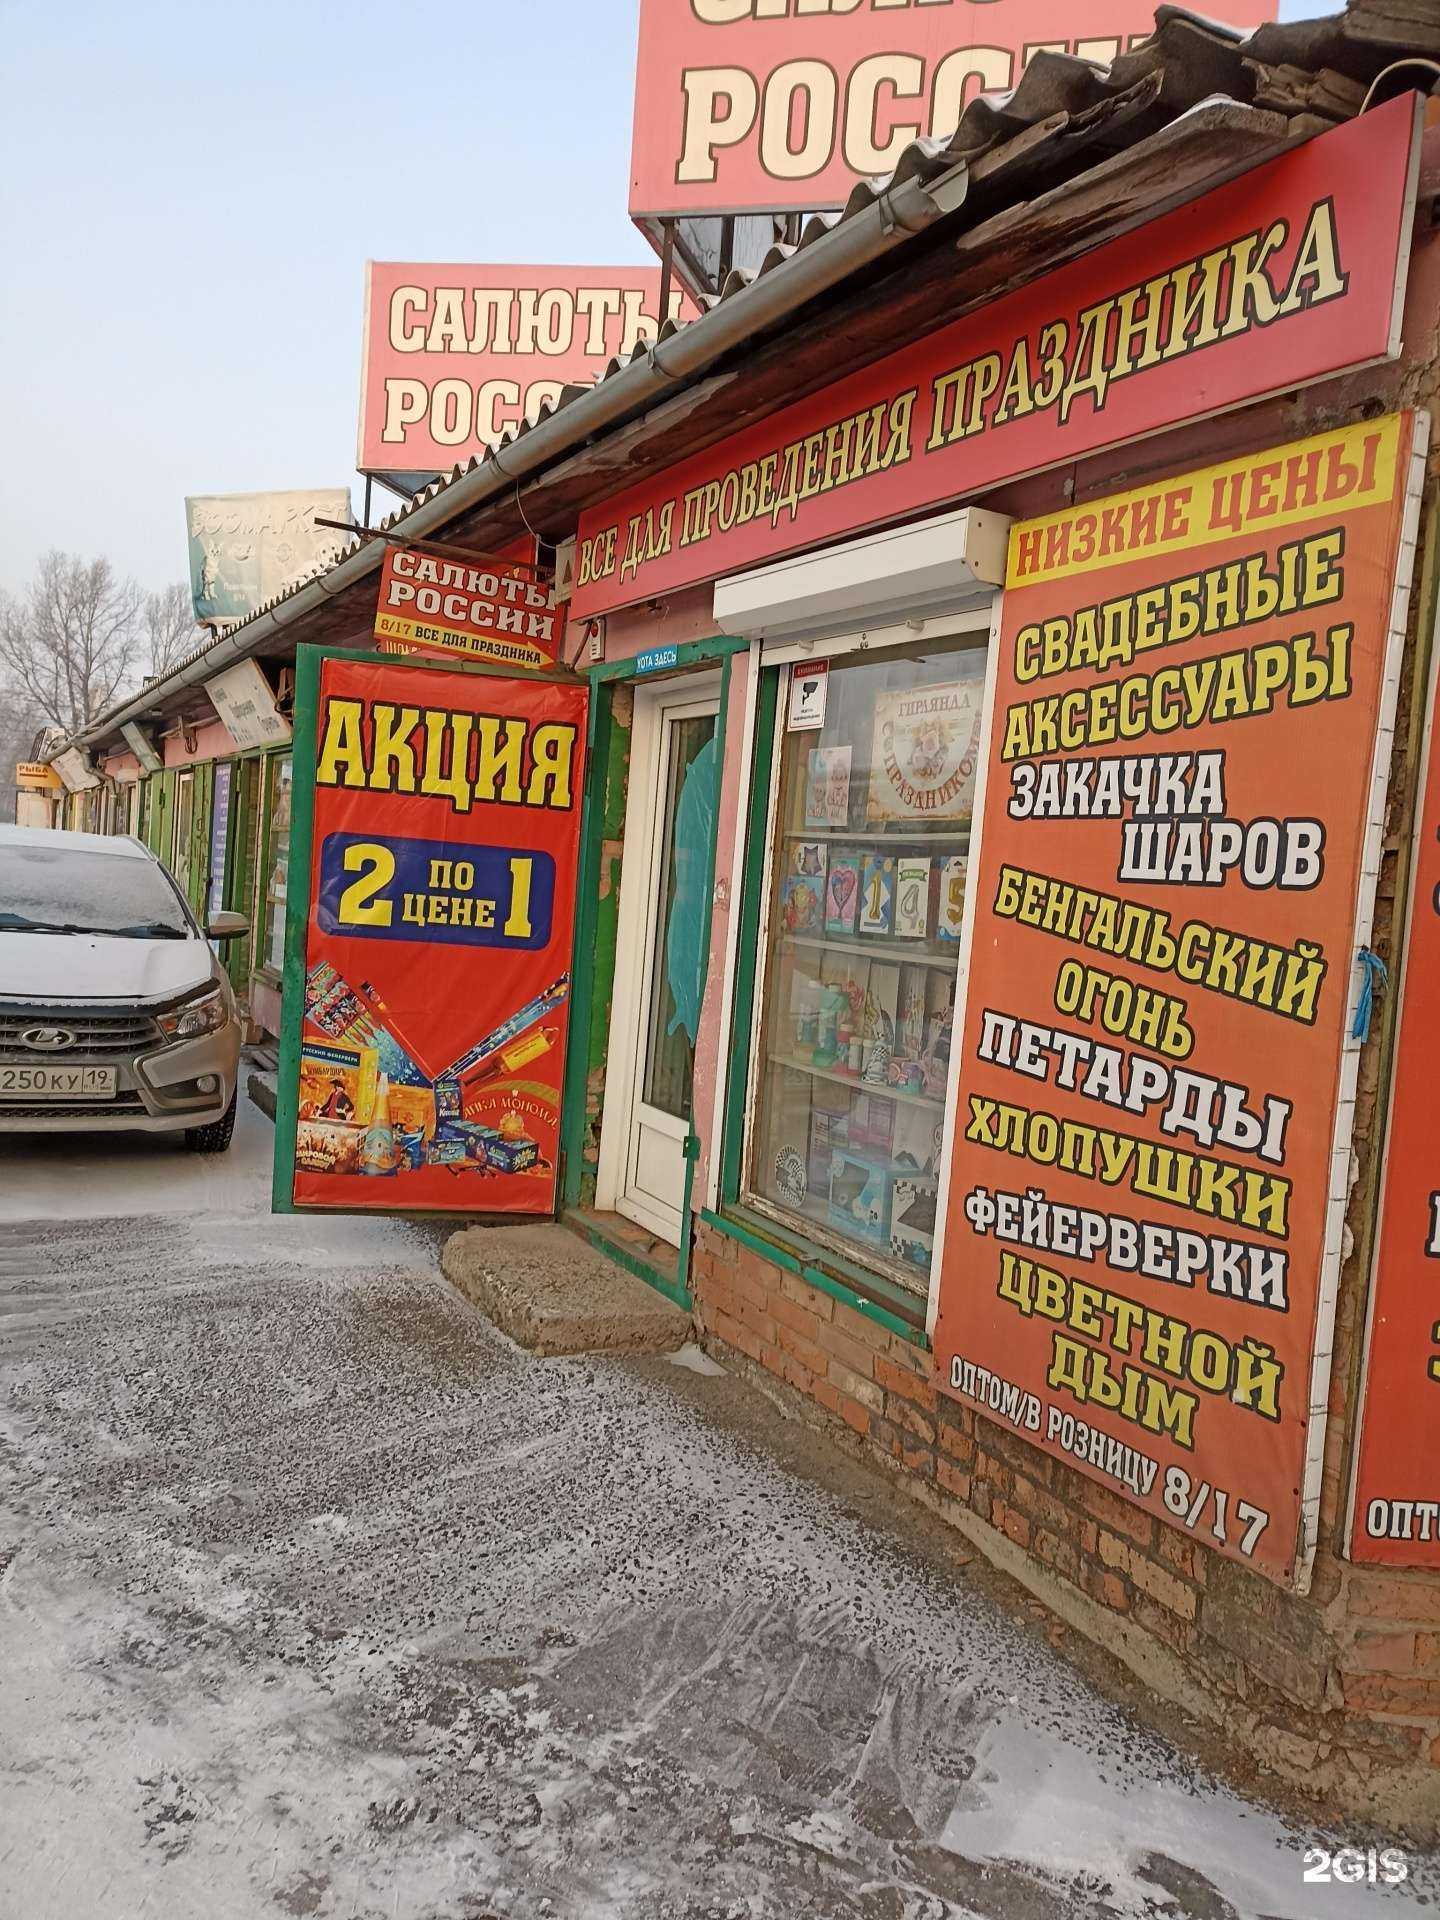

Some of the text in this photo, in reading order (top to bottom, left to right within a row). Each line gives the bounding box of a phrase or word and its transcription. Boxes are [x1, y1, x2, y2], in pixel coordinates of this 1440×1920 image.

[675, 34, 1160, 184] РОСС
[577, 198, 1346, 584] ВСЕ ДЛЯ ПРОВЕДЕНИЯ ПРАЗДНИКА
[1015, 434, 1381, 577] НИЗКИЕ ЦЕНЫ
[387, 580, 555, 640] РОССИИ
[392, 552, 557, 610] САЛЮТЫ
[1013, 526, 1345, 684] СВАДЕБНЫЕ
[380, 619, 541, 664] 8/17 ВСЕ ДЛЯ ПРАЗДНИКА
[655, 650, 677, 665] ЗДЕСЬ
[1001, 623, 1353, 762] АКСЕССУАРЫ
[315, 697, 578, 814] АКЦИЯ
[1007, 749, 1227, 820] ЗАКАЧКА
[338, 842, 396, 928] 2
[428, 858, 474, 891] ПО
[503, 857, 534, 938] 1
[1117, 817, 1325, 889] ШАРОВ
[402, 890, 496, 931] ЦЕНЕ
[994, 866, 1325, 1025] БЕНГАЛЬСКИЙ
[1054, 958, 1195, 1060] ОГОНЬ
[87, 1070, 109, 1085] 19
[976, 1008, 1293, 1163] ПЕТАРДЫ
[964, 1095, 1293, 1240] ХЛОПУШКИ
[964, 1186, 1290, 1312] ФЕЙЕРВЕРКИ
[997, 1252, 1283, 1420] ЦВЕТНОЙ
[1046, 1332, 1200, 1450] ДЫМ
[949, 1354, 1272, 1562] ОПТОМ/В РОЗНИЦУ 8/17
[1366, 1498, 1440, 1542] ОПТ
